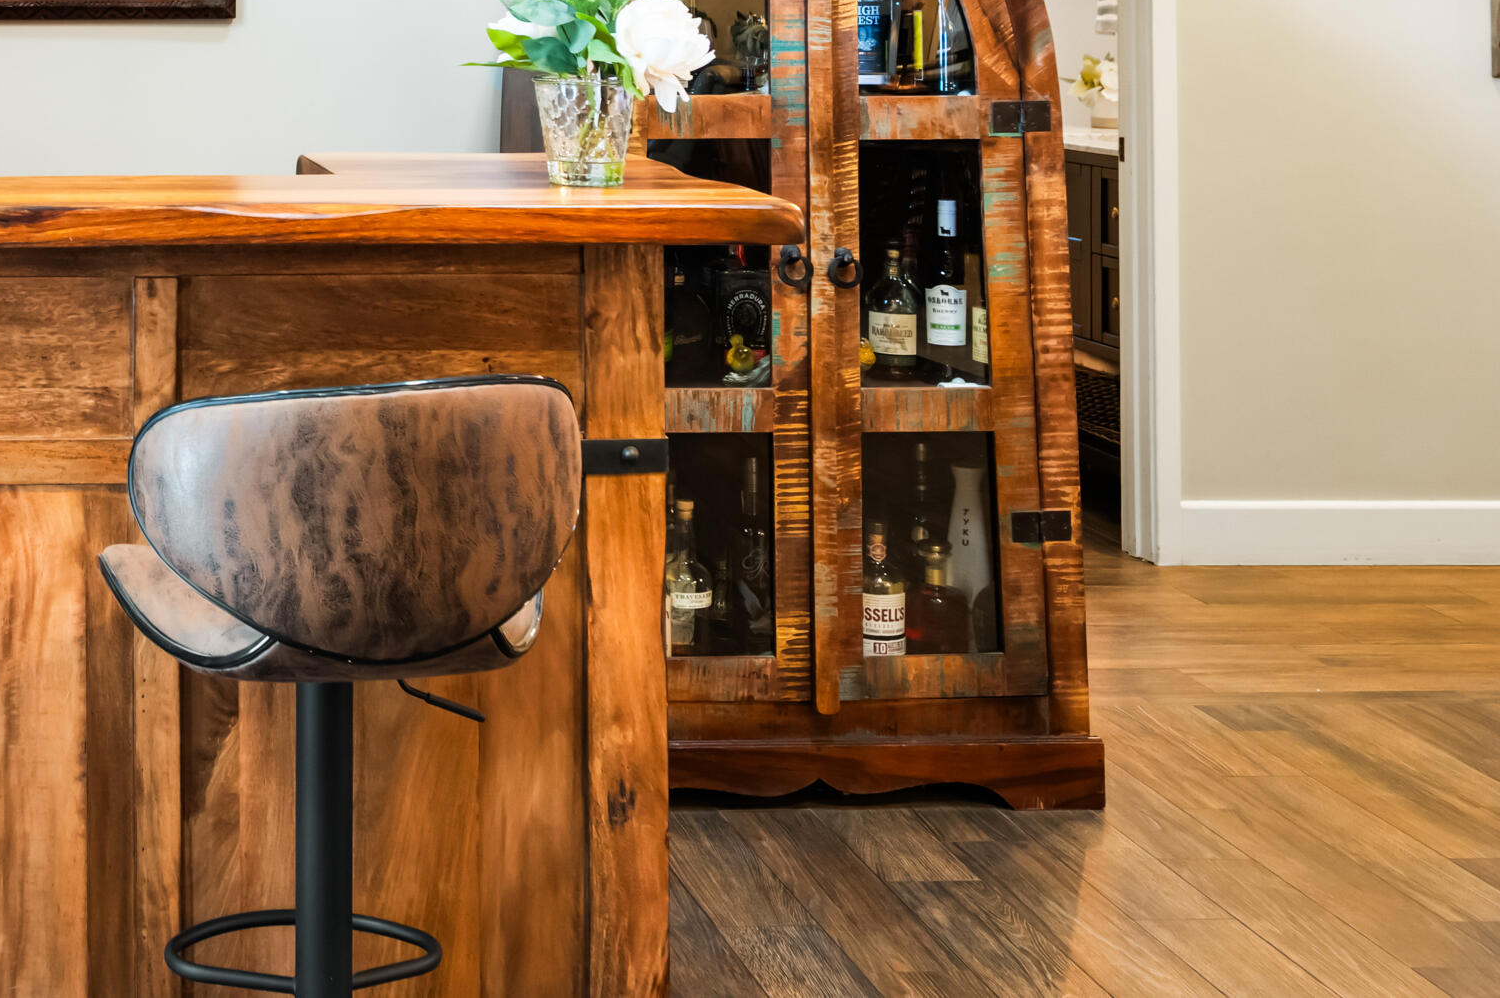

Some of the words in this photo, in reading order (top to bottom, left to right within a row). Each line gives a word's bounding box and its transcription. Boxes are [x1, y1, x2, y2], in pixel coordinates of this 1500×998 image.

[858, 5, 879, 15] IGH
[858, 15, 879, 25] EST
[727, 293, 766, 310] HERRADURA
[864, 606, 905, 622] SSELL'S
[875, 643, 887, 654] 10
